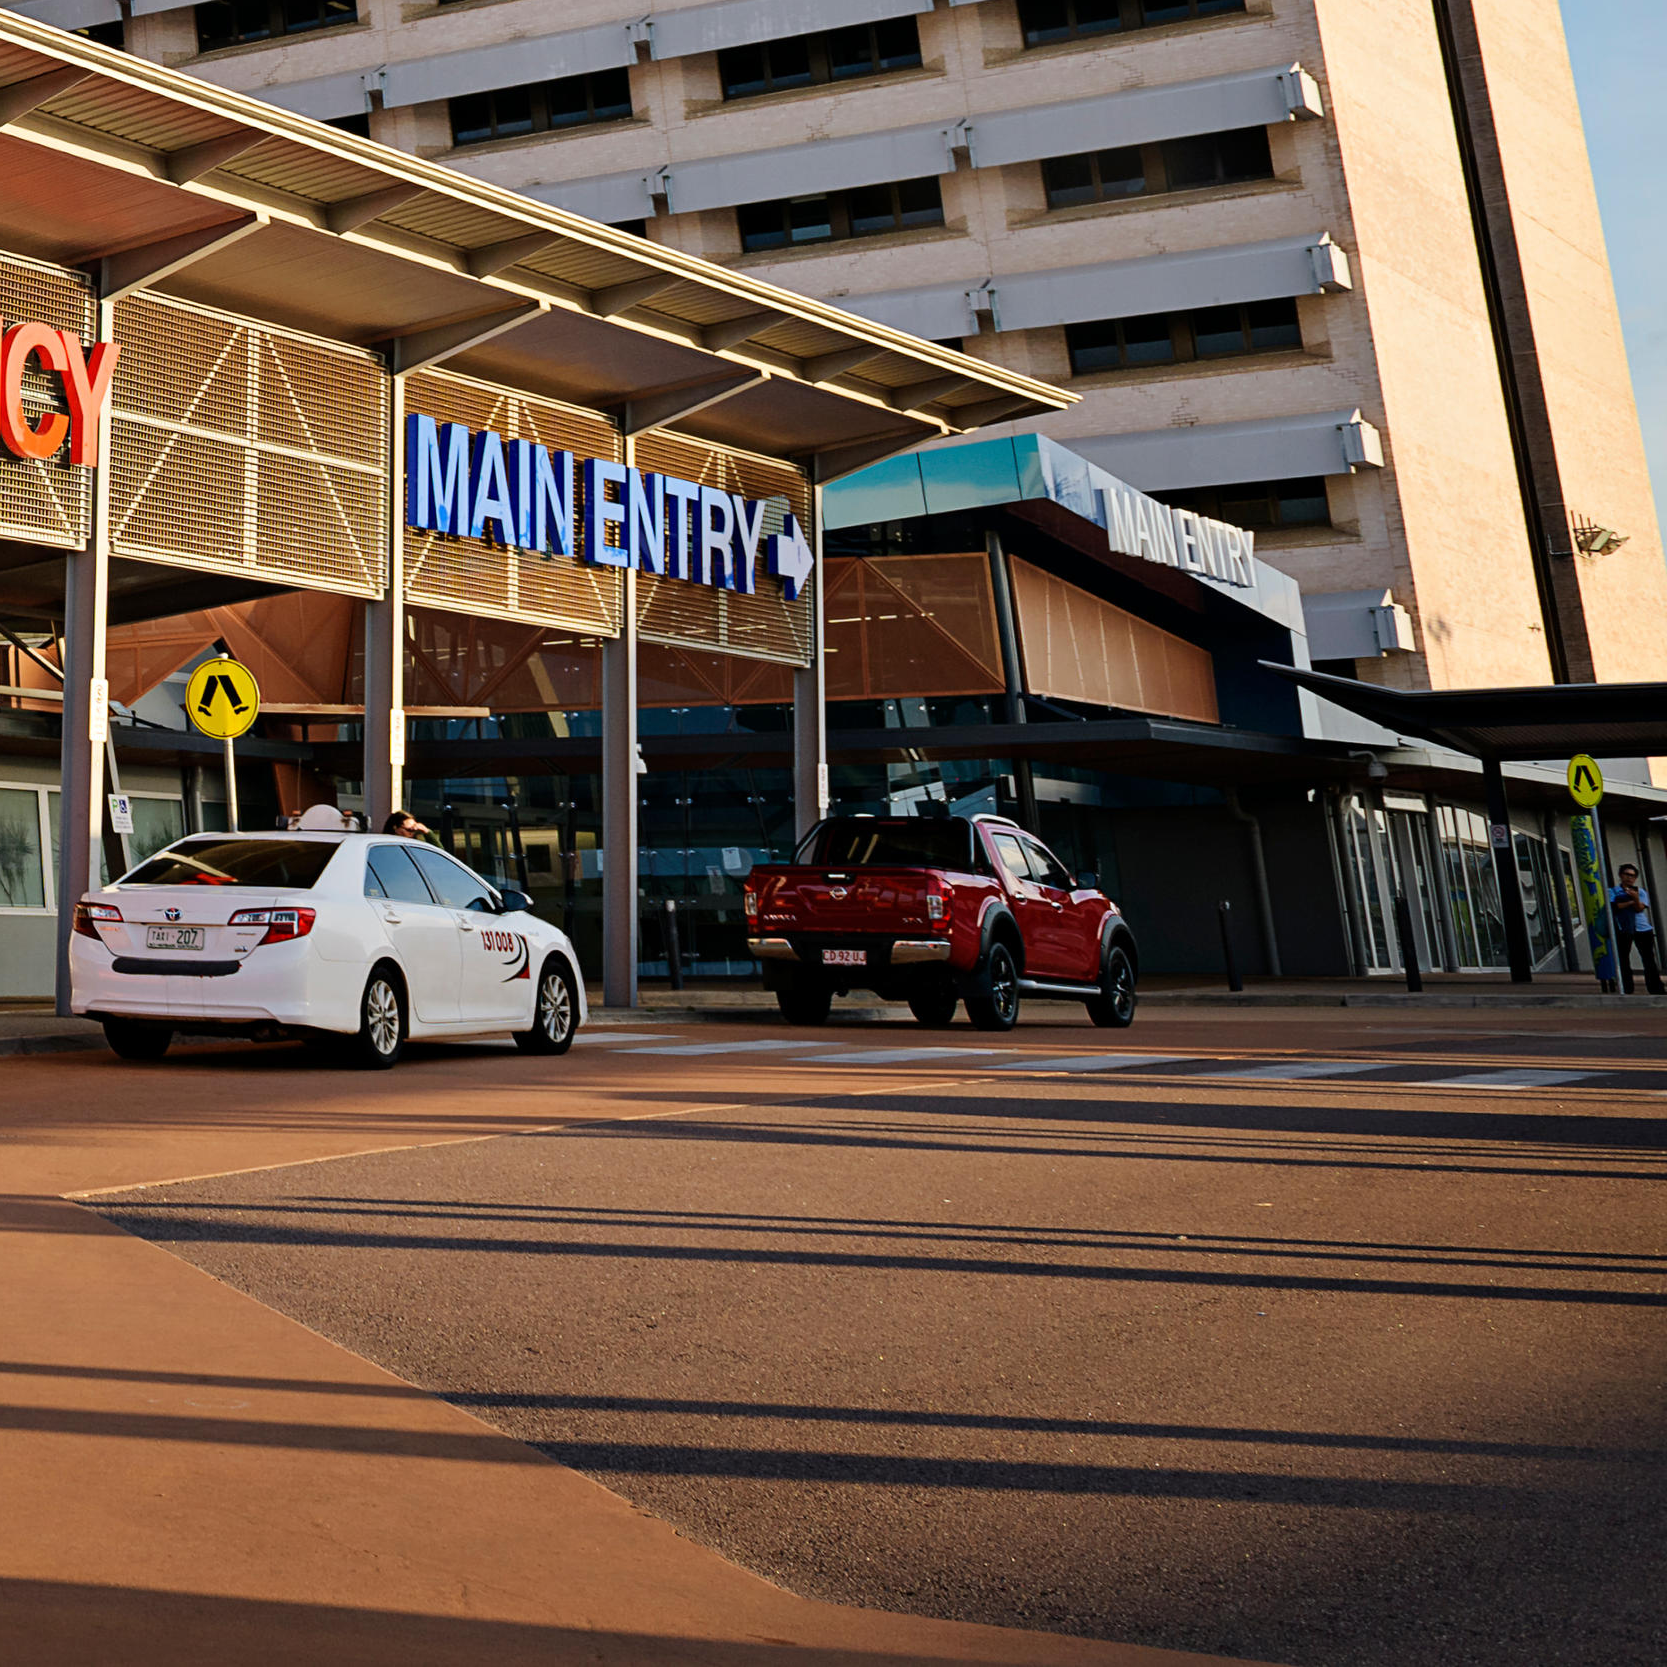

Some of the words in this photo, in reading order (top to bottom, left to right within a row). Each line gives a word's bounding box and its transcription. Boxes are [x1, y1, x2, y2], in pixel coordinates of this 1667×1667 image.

[407, 412, 575, 556] MAIN
[584, 457, 766, 595] ENTRY
[1103, 487, 1179, 567] MAIN
[1172, 508, 1257, 587] ENTRY
[151, 930, 170, 942] TAXI
[176, 929, 199, 945] 207
[823, 951, 836, 961] CD
[838, 951, 850, 962] 92
[852, 951, 867, 962] UJ
